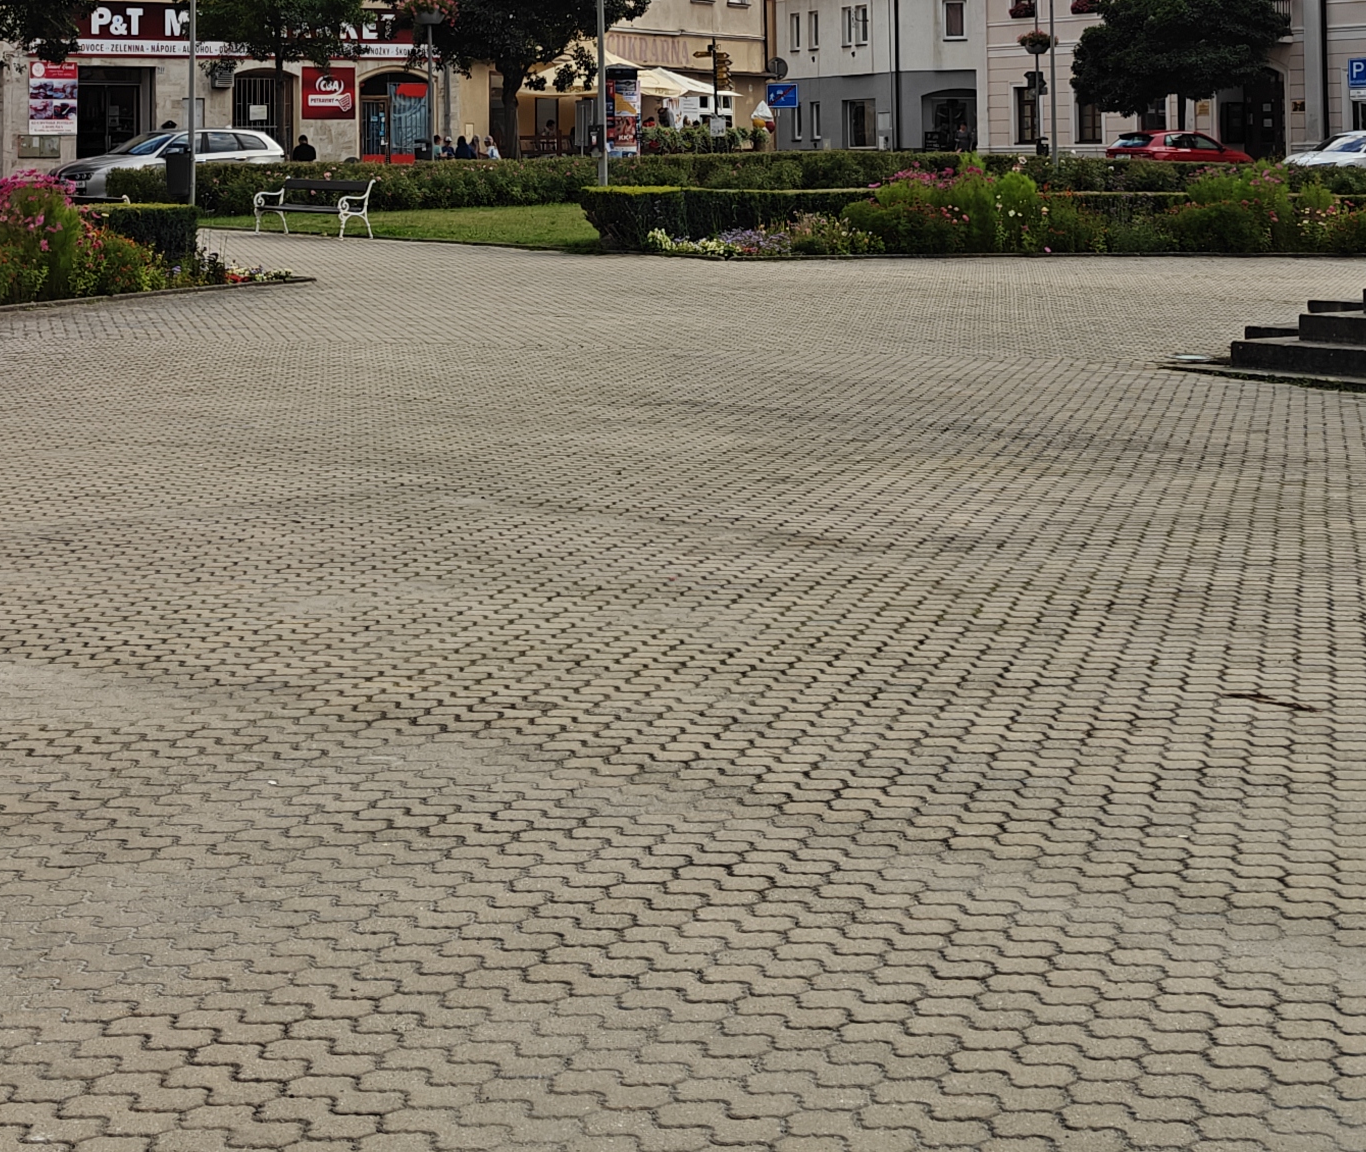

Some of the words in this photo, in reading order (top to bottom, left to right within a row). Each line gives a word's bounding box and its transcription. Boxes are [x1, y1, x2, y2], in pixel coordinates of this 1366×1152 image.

[91, 6, 143, 36] P&T
[80, 43, 104, 52] OVOCE
[111, 43, 145, 53] ZELENINA
[150, 42, 176, 53] NÁPOJE
[182, 43, 213, 54] ALOHOL
[1352, 61, 1365, 79] P
